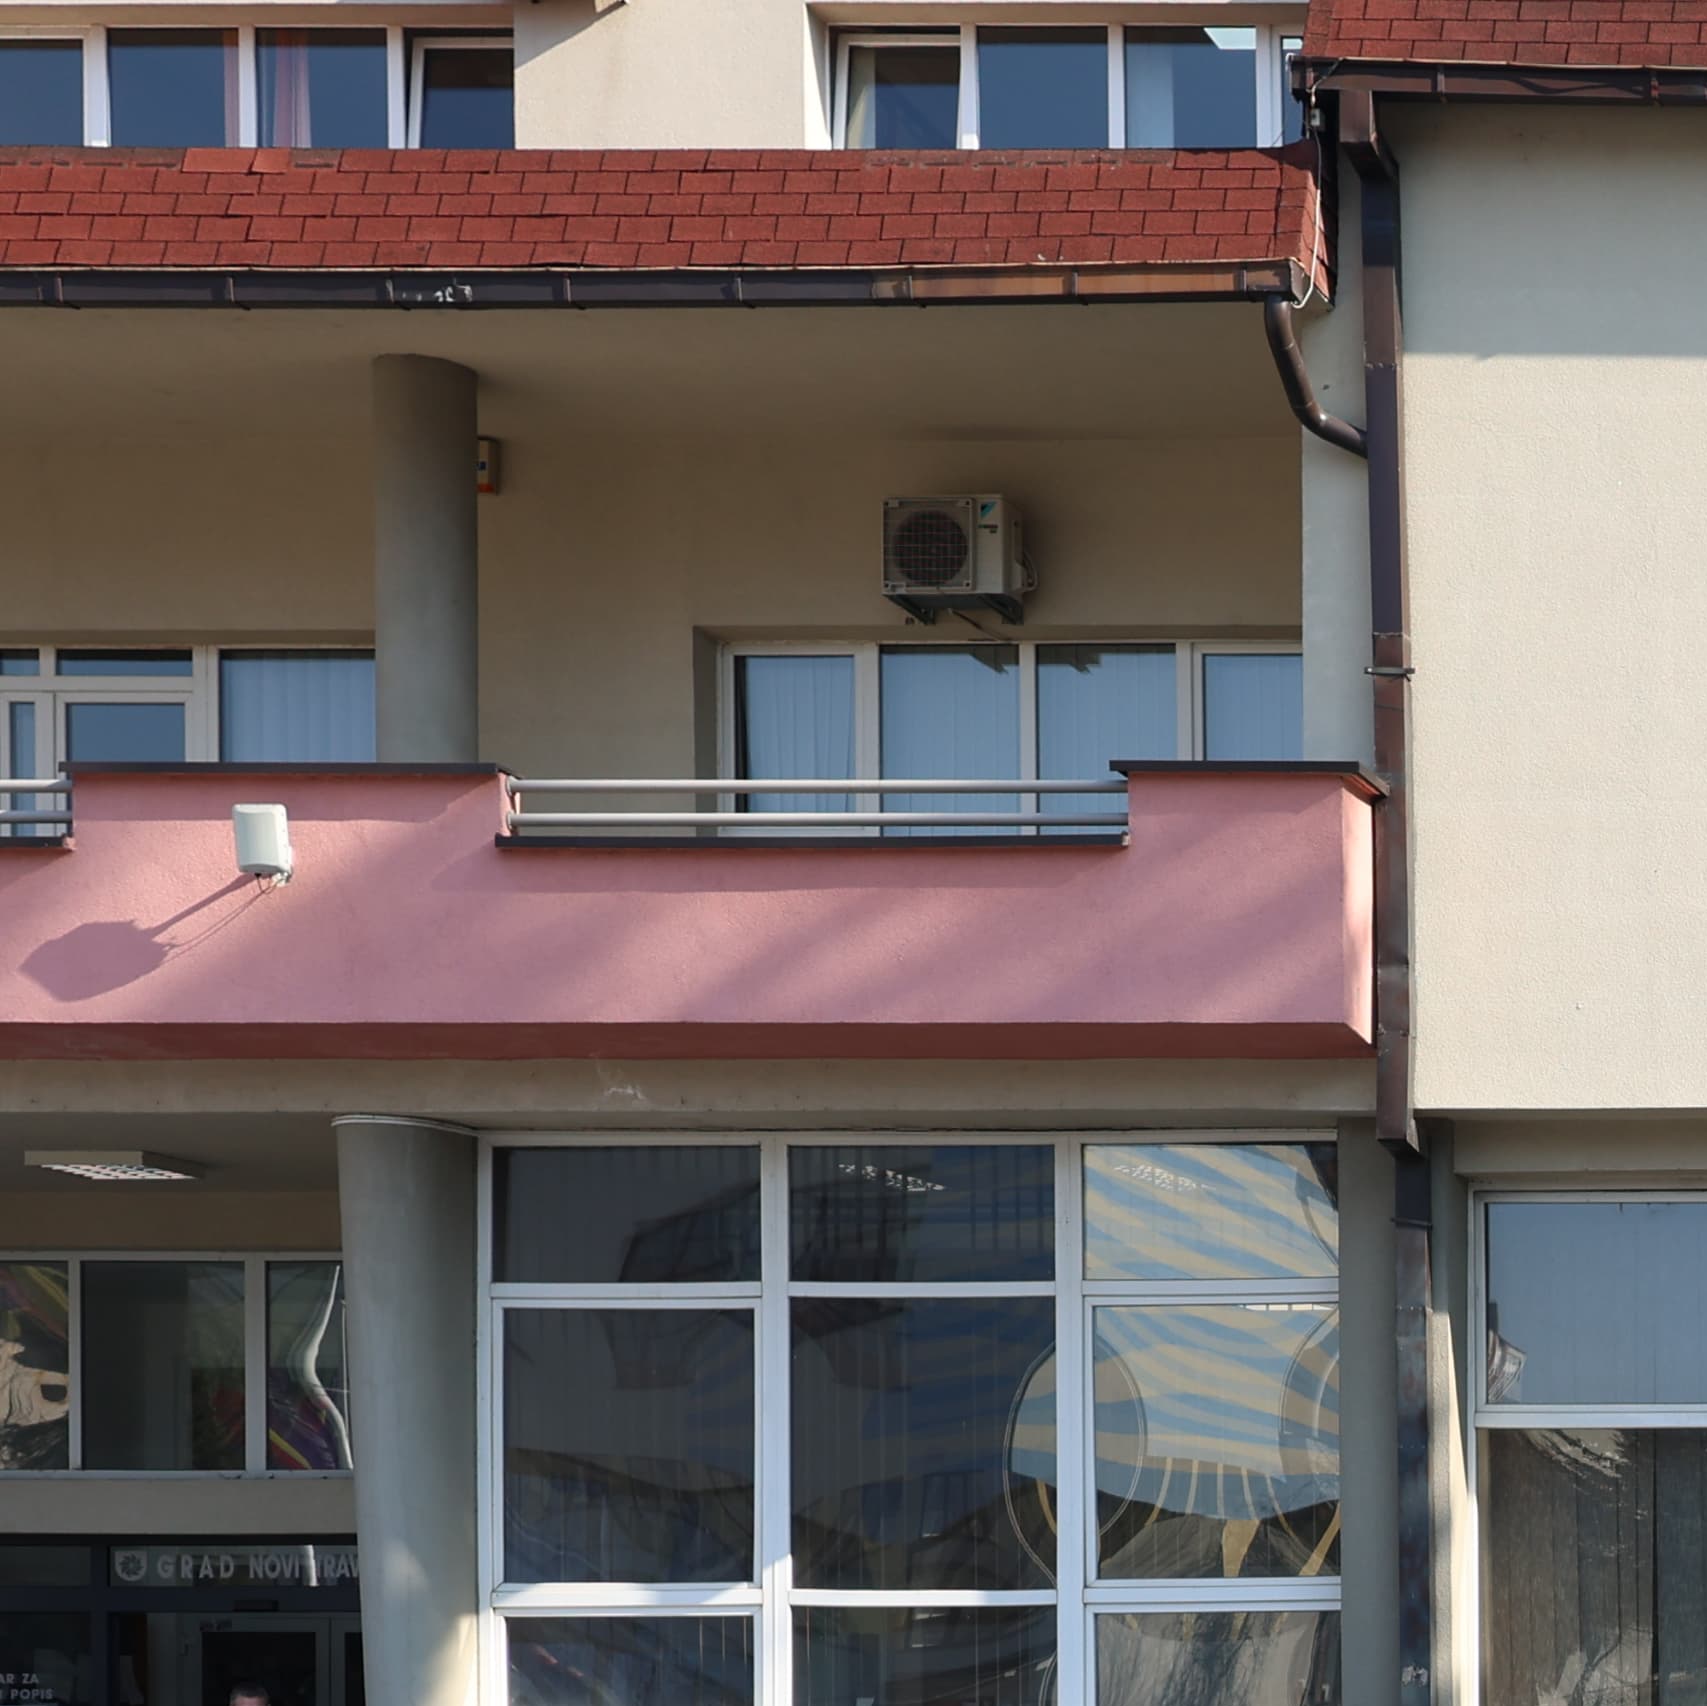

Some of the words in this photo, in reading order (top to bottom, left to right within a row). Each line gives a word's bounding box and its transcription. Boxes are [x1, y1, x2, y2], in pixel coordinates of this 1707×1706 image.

[157, 1553, 235, 1579] GRAD
[249, 1552, 300, 1579] NOVI
[22, 1672, 39, 1684] ZA
[10, 1688, 53, 1700] POPIS
